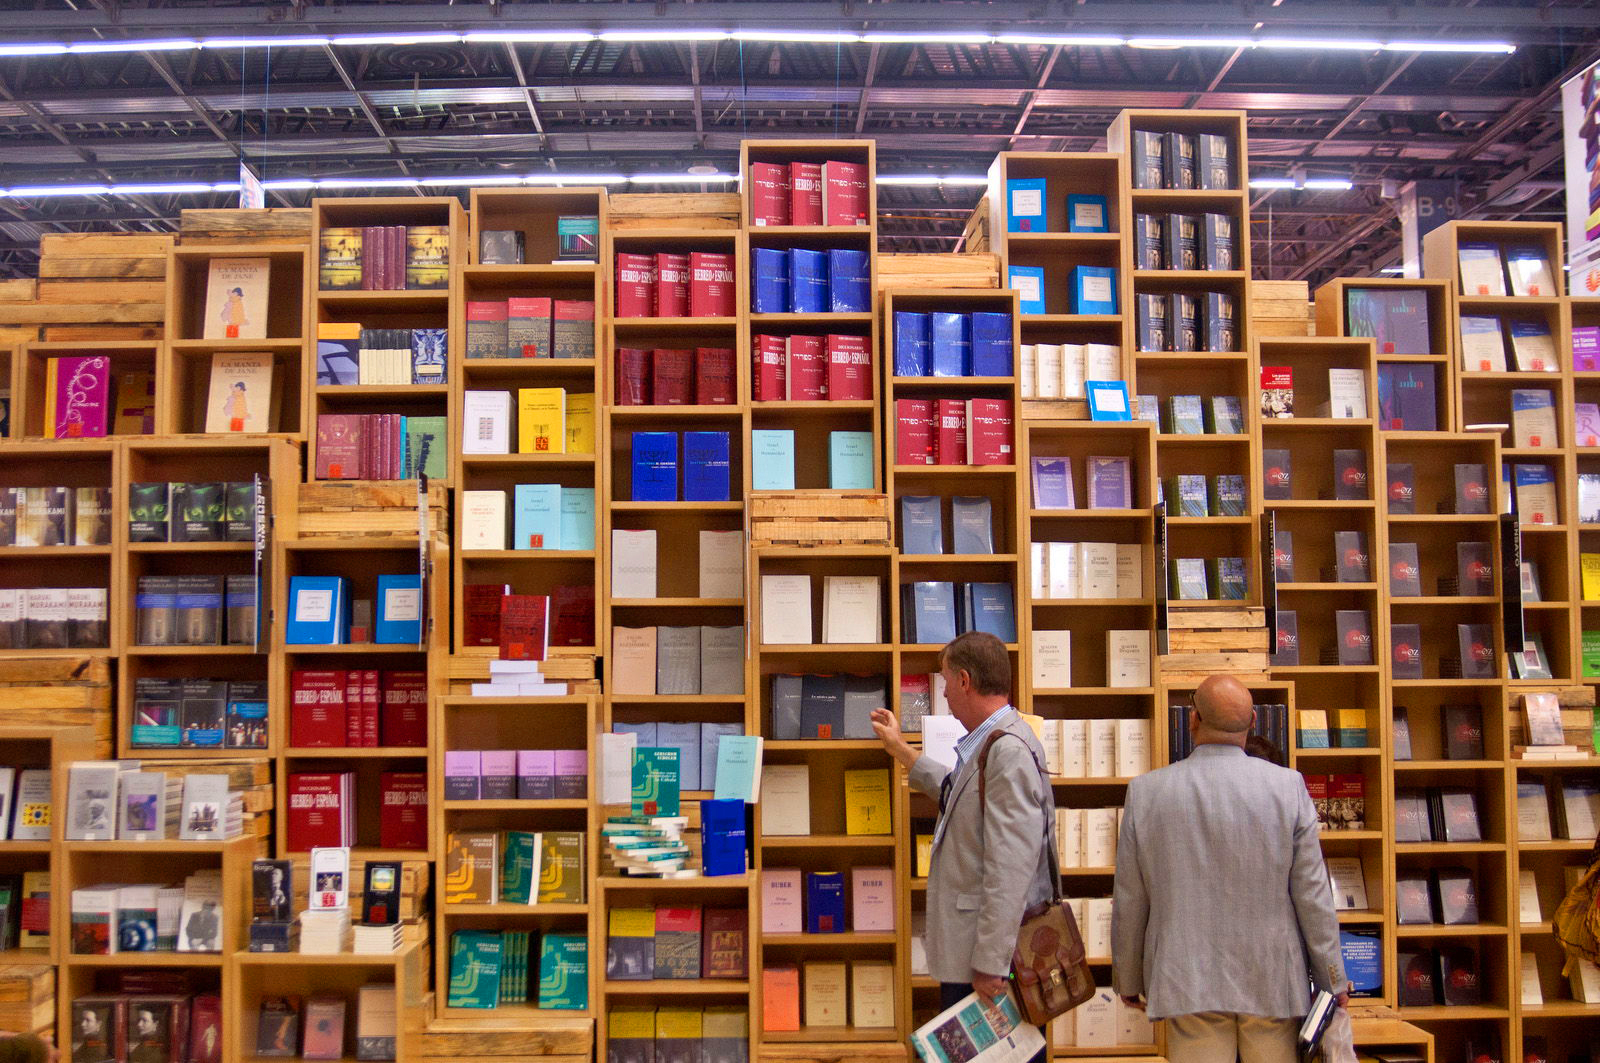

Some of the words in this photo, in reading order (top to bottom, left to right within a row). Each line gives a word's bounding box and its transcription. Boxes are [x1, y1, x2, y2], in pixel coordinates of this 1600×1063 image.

[621, 269, 639, 282] HEBREO
[661, 269, 678, 282] HEBREO
[694, 268, 712, 281] HEBREO
[714, 268, 733, 282] ESPAÑOL
[832, 351, 849, 363] HEBREO
[851, 350, 870, 365] ESPAÑOL
[942, 416, 959, 428] HEBREO
[295, 690, 318, 704] HEBREO
[320, 687, 343, 704] ESPAÑOL
